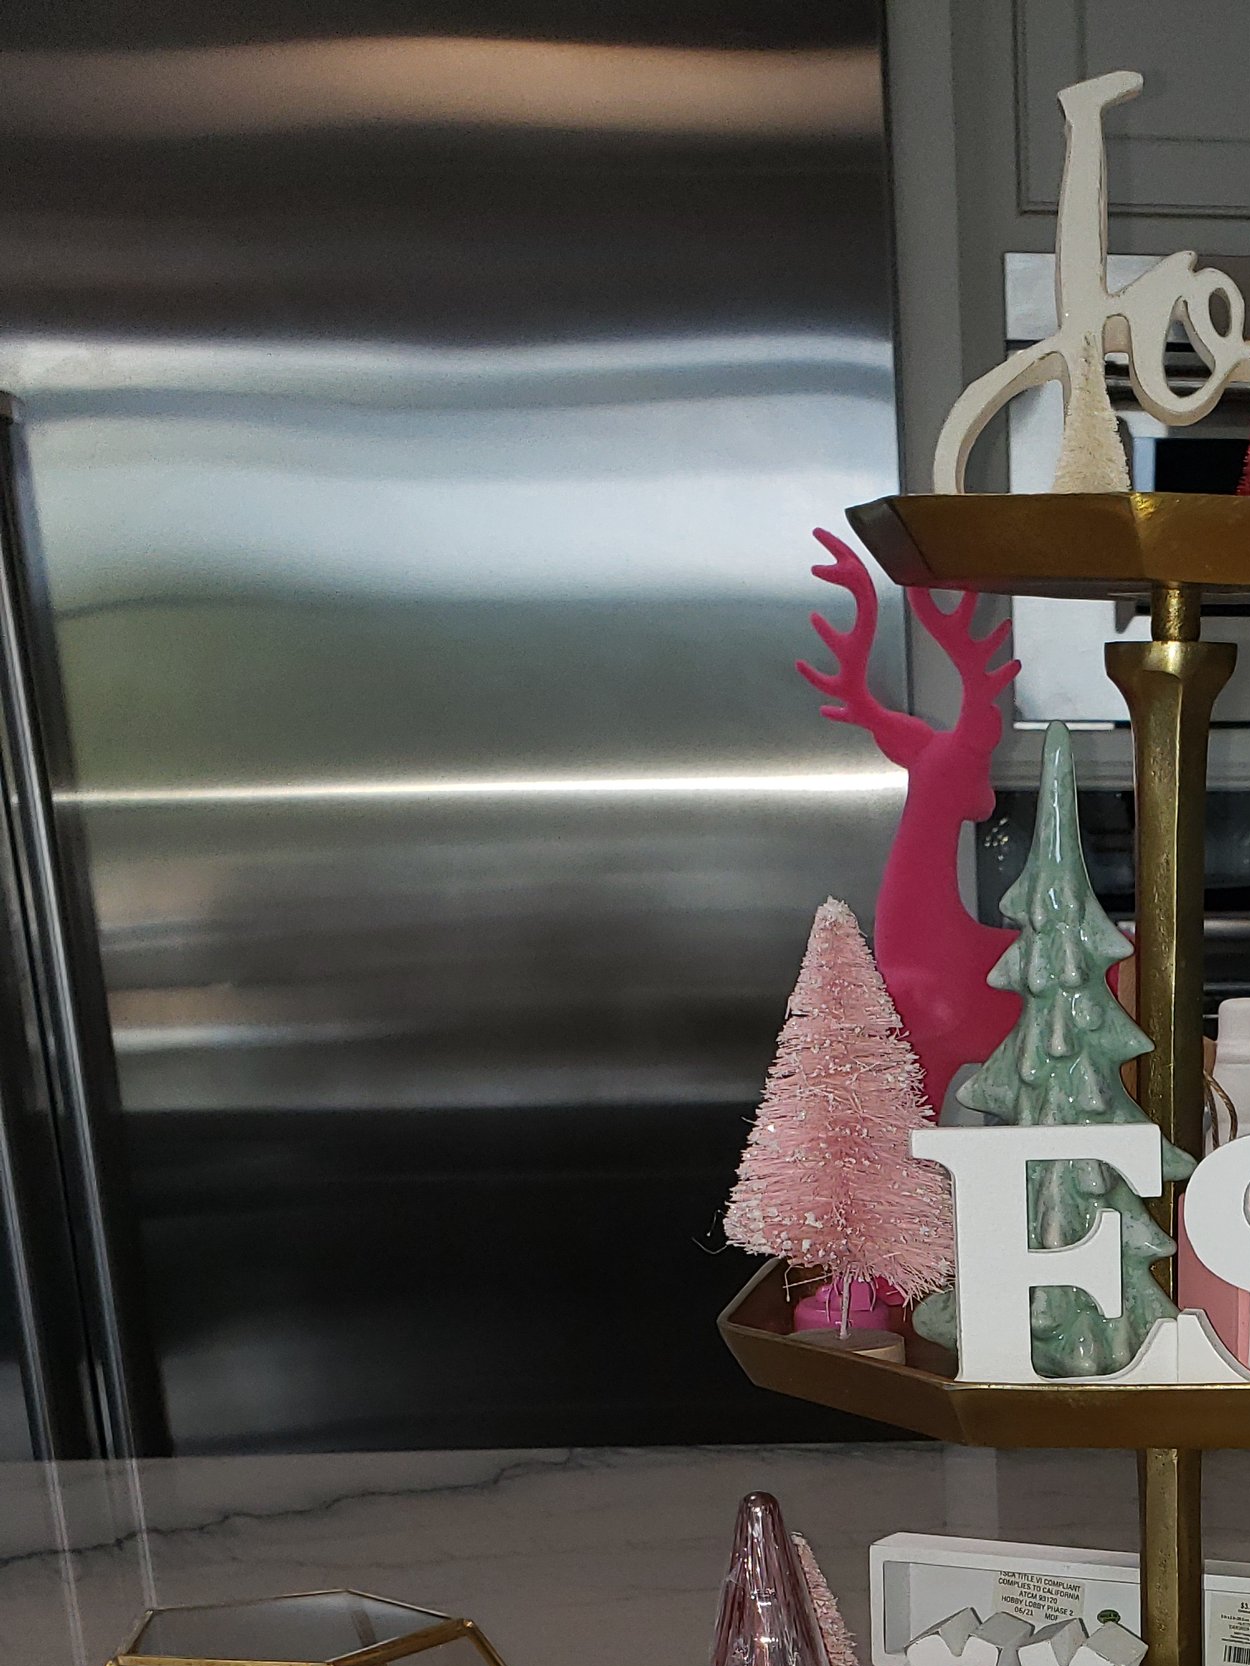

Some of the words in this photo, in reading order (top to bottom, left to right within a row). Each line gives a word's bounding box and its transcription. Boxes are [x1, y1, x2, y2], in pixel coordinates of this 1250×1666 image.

[998, 1577, 1031, 1590] COMPLIES
[1042, 1586, 1080, 1601] CALIFORNIA
[1016, 1572, 1034, 1582] TITLE
[1043, 1579, 1081, 1592] COMPLIANT
[1001, 1595, 1023, 1605] HOBBY
[1024, 1601, 1045, 1610] LOBBY
[1046, 1605, 1068, 1615] PHASE
[1018, 1590, 1038, 1600] ATCM
